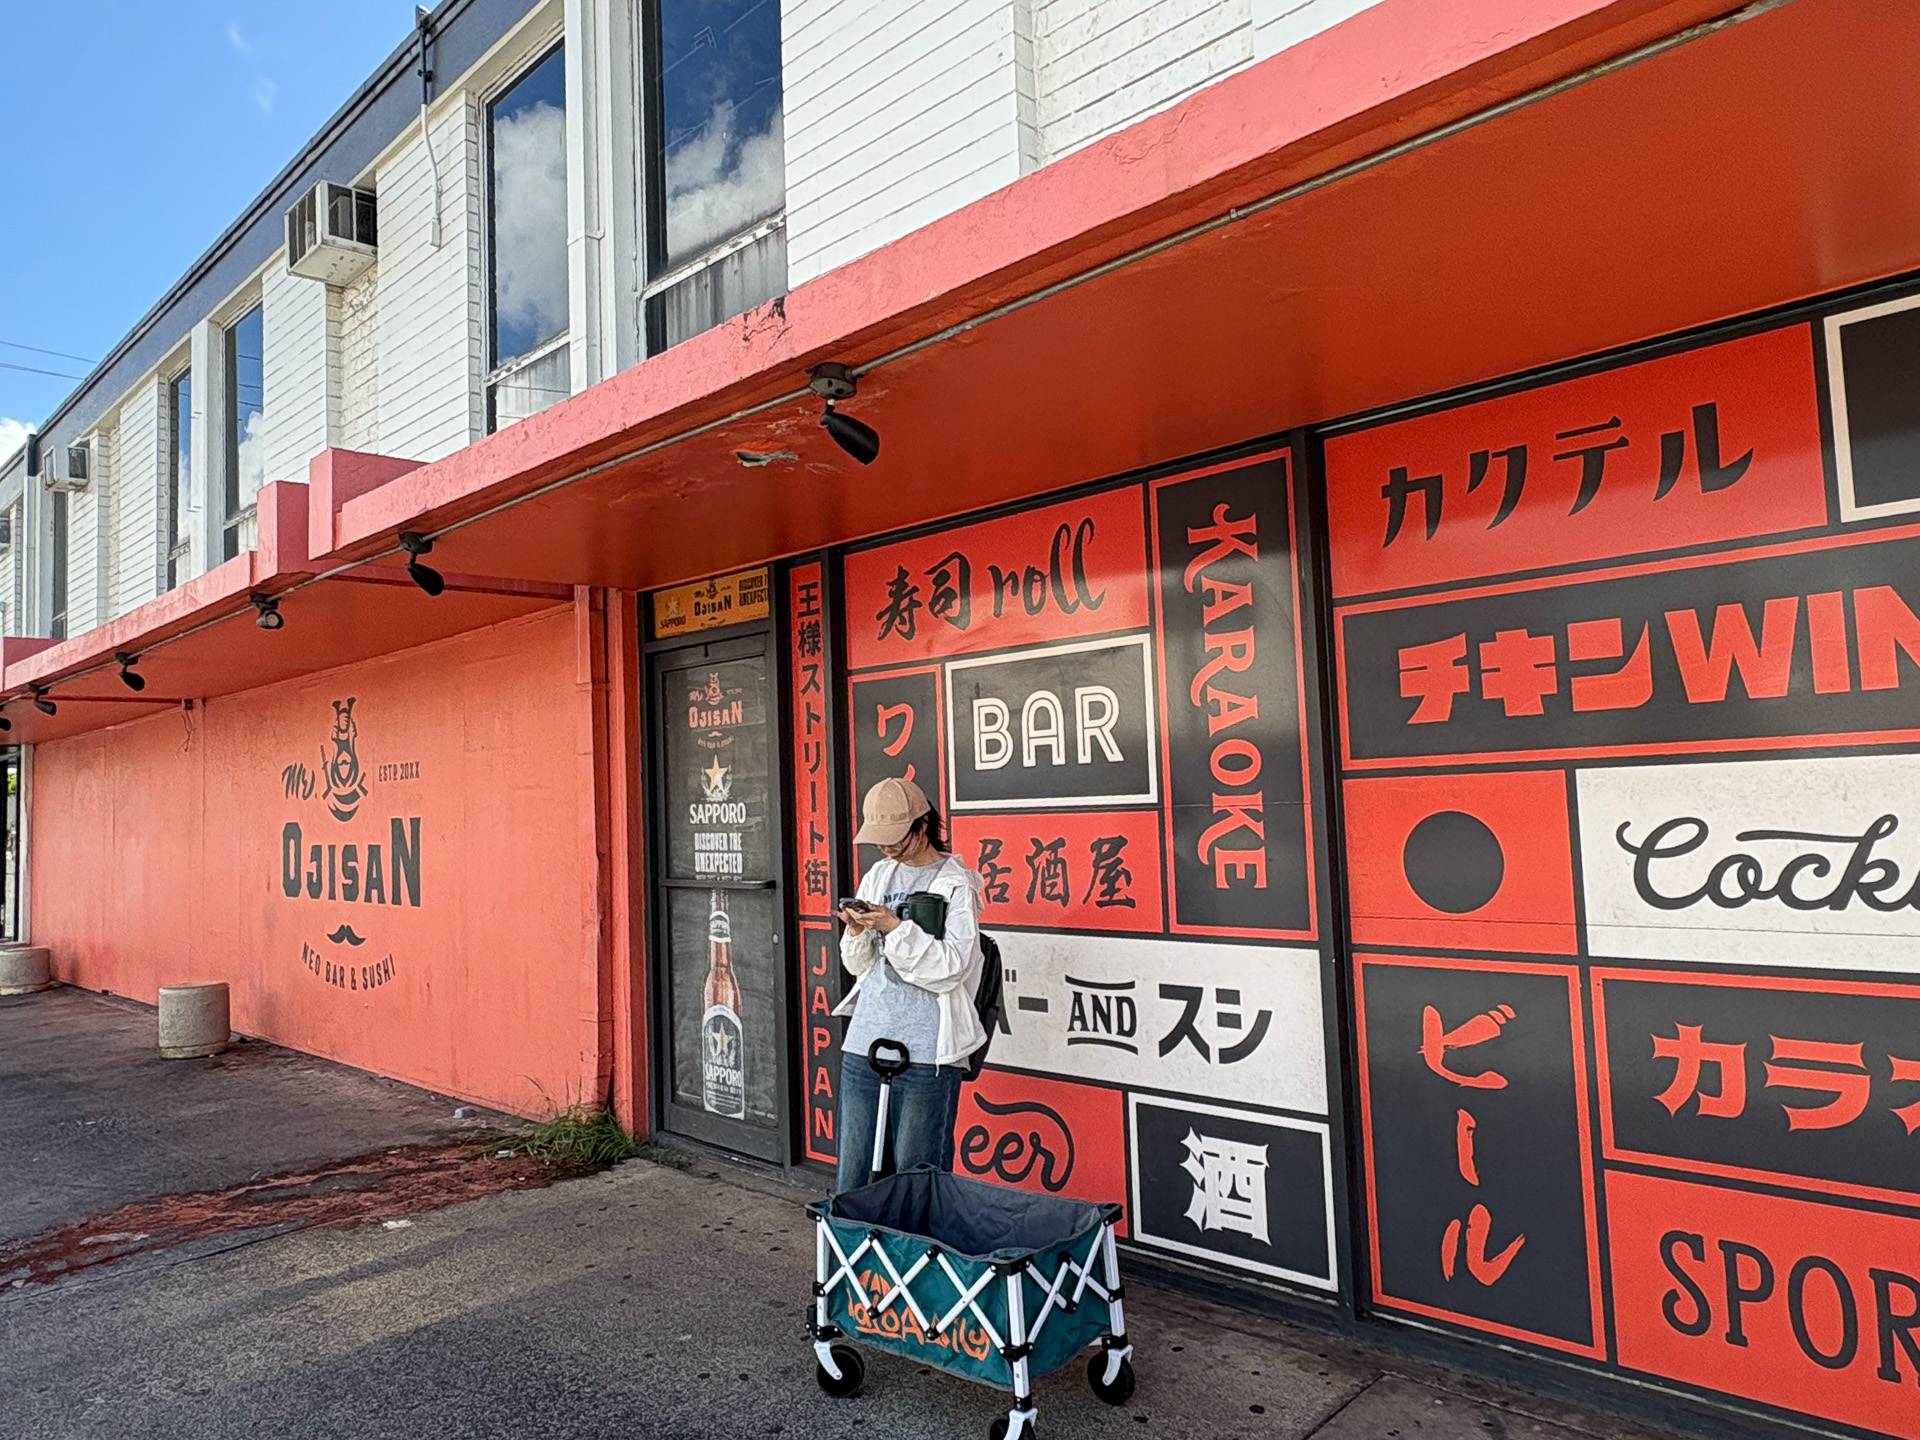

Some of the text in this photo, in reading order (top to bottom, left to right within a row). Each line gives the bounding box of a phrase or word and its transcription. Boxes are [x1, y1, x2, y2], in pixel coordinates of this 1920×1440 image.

[1381, 402, 1755, 548] カクテル
[694, 594, 732, 617] OJISAN
[876, 518, 1107, 641] 寿司 roll
[660, 615, 687, 629] SAPPORO
[688, 700, 743, 728] OJISAN
[973, 685, 1125, 771] BAR
[1184, 503, 1268, 890] KARAOKE
[400, 761, 420, 780] 20XX
[796, 581, 829, 898] 王様ストリート街
[877, 702, 916, 781] ワ
[689, 802, 747, 824] SAPPORO
[694, 832, 742, 851] DISCOVER THE
[281, 816, 422, 907] OJISAN
[694, 852, 743, 874] UNEXPECTED
[979, 835, 1137, 910] 居酒屋
[1616, 813, 1920, 912] Cock
[302, 941, 396, 991] NEO BAR & SUSHI
[812, 946, 835, 1140] JAPAN
[1067, 991, 1138, 1047] AND
[1158, 982, 1274, 1065] スシ
[960, 1091, 1075, 1192] eer
[1417, 1004, 1527, 1287] ビール
[1180, 1126, 1274, 1248] 酒
